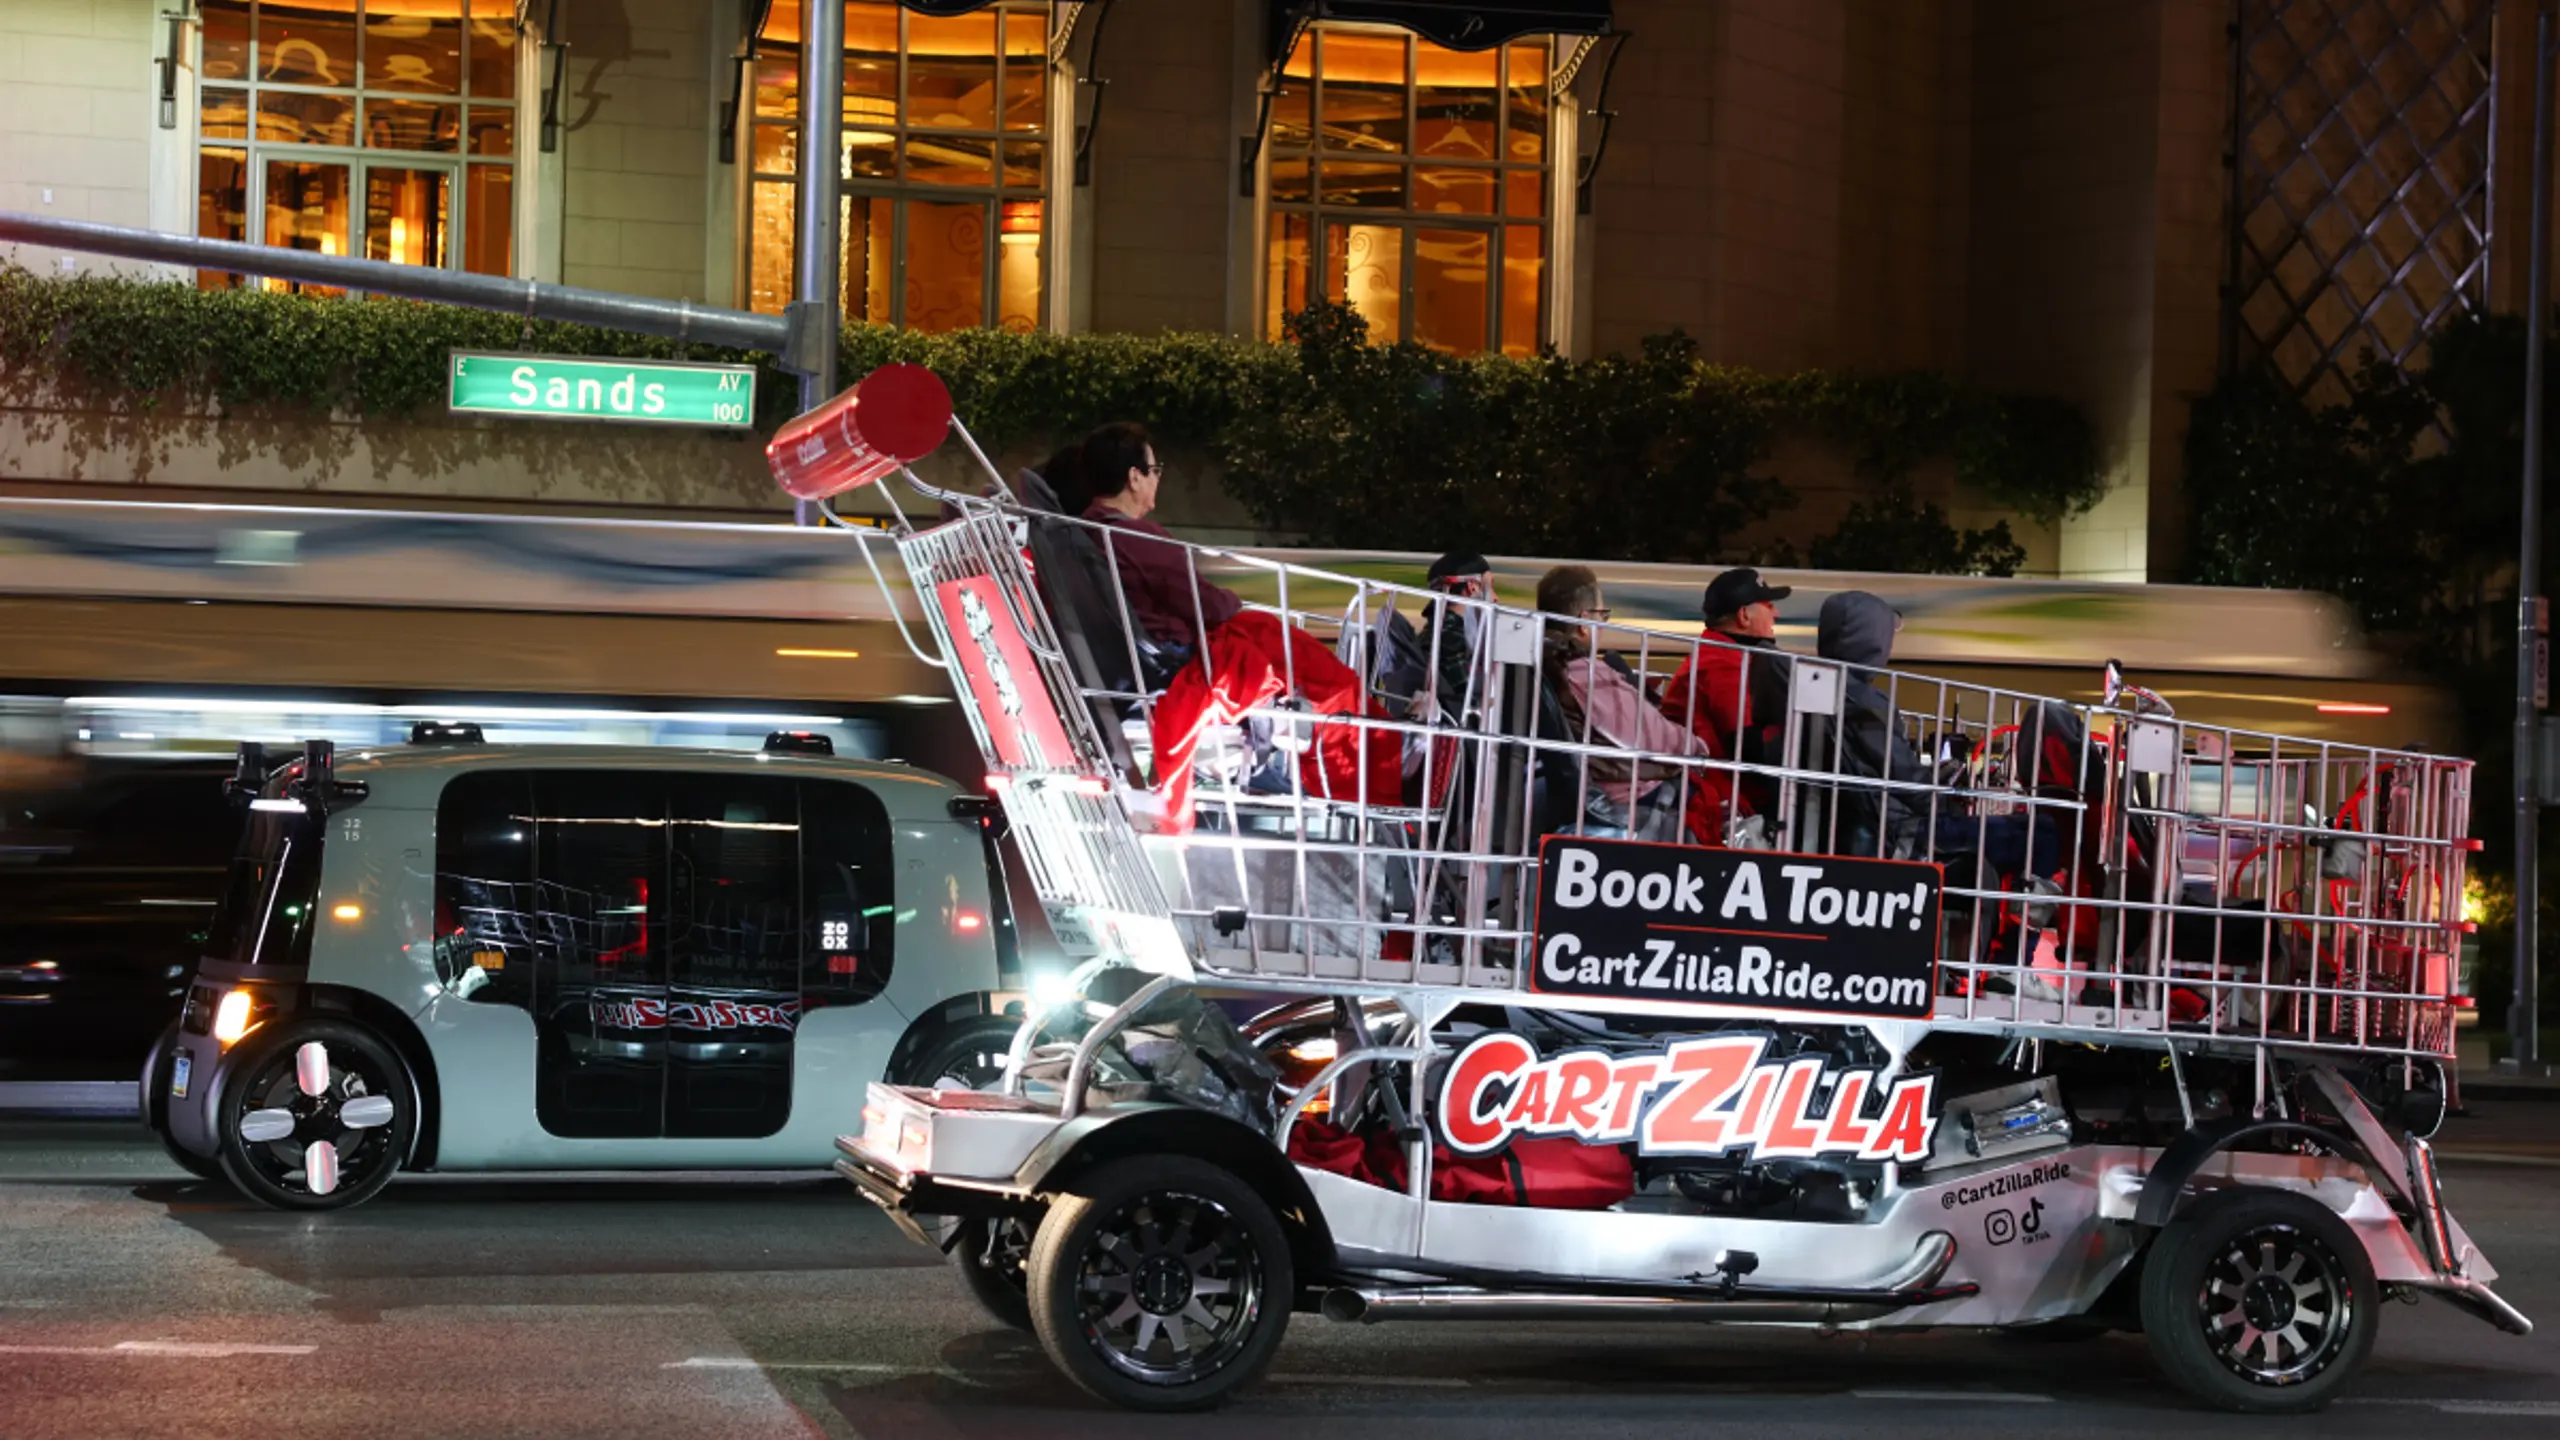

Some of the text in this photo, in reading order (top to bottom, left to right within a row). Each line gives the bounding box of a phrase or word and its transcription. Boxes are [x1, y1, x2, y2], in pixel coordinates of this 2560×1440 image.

[457, 358, 666, 414] E Sands
[718, 374, 742, 391] AV
[714, 403, 743, 421] 100
[343, 818, 361, 828] 32
[1555, 847, 1928, 931] Book A Tour!
[1541, 932, 1927, 1007] CartZillaRide.com
[1441, 1032, 1938, 1163] CARTZILLA
[1941, 1162, 2070, 1209] @CartZillaRide
